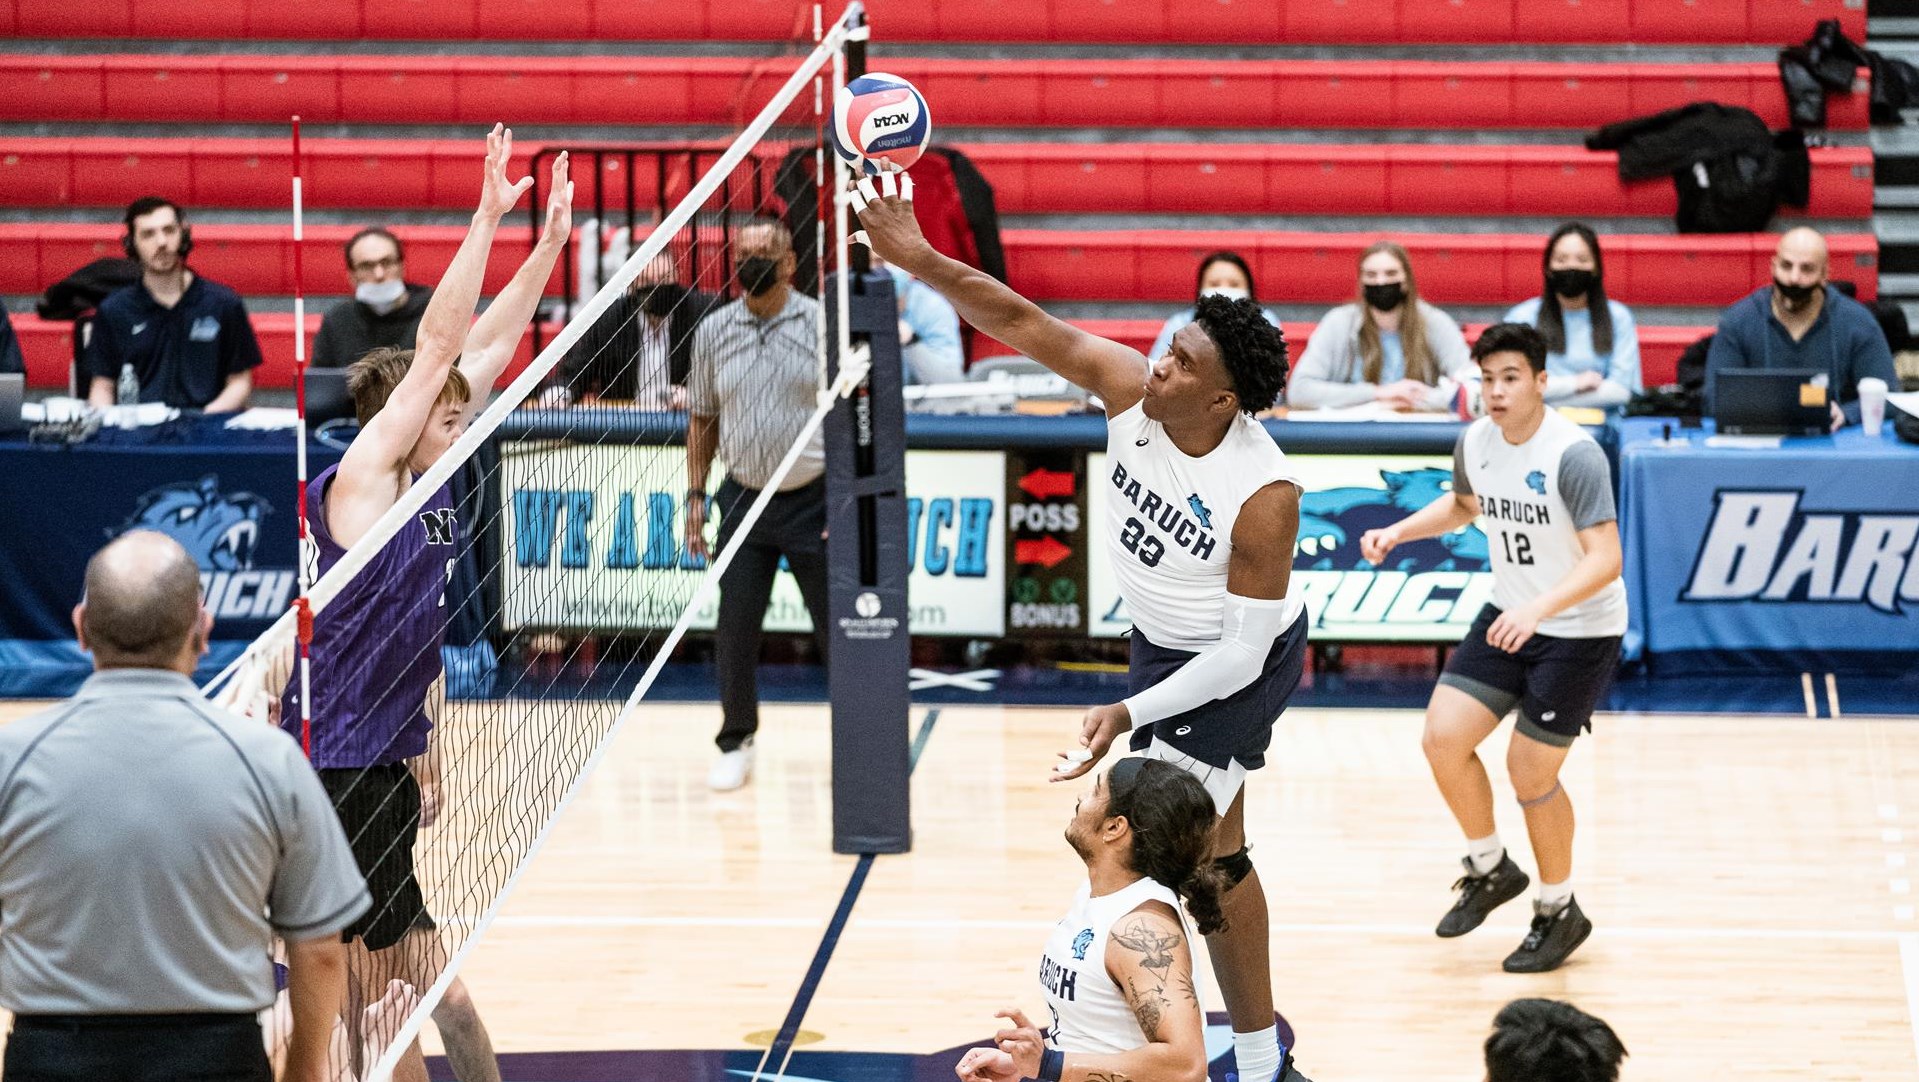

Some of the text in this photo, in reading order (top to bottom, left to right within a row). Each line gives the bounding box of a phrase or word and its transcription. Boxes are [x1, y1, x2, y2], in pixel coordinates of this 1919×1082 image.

[874, 113, 909, 128] NCAA
[1009, 503, 1079, 532] POSS
[1112, 460, 1216, 561] BARUCH
[513, 490, 592, 568] WE
[1501, 530, 1534, 566] 12
[1010, 602, 1080, 628] BONUS
